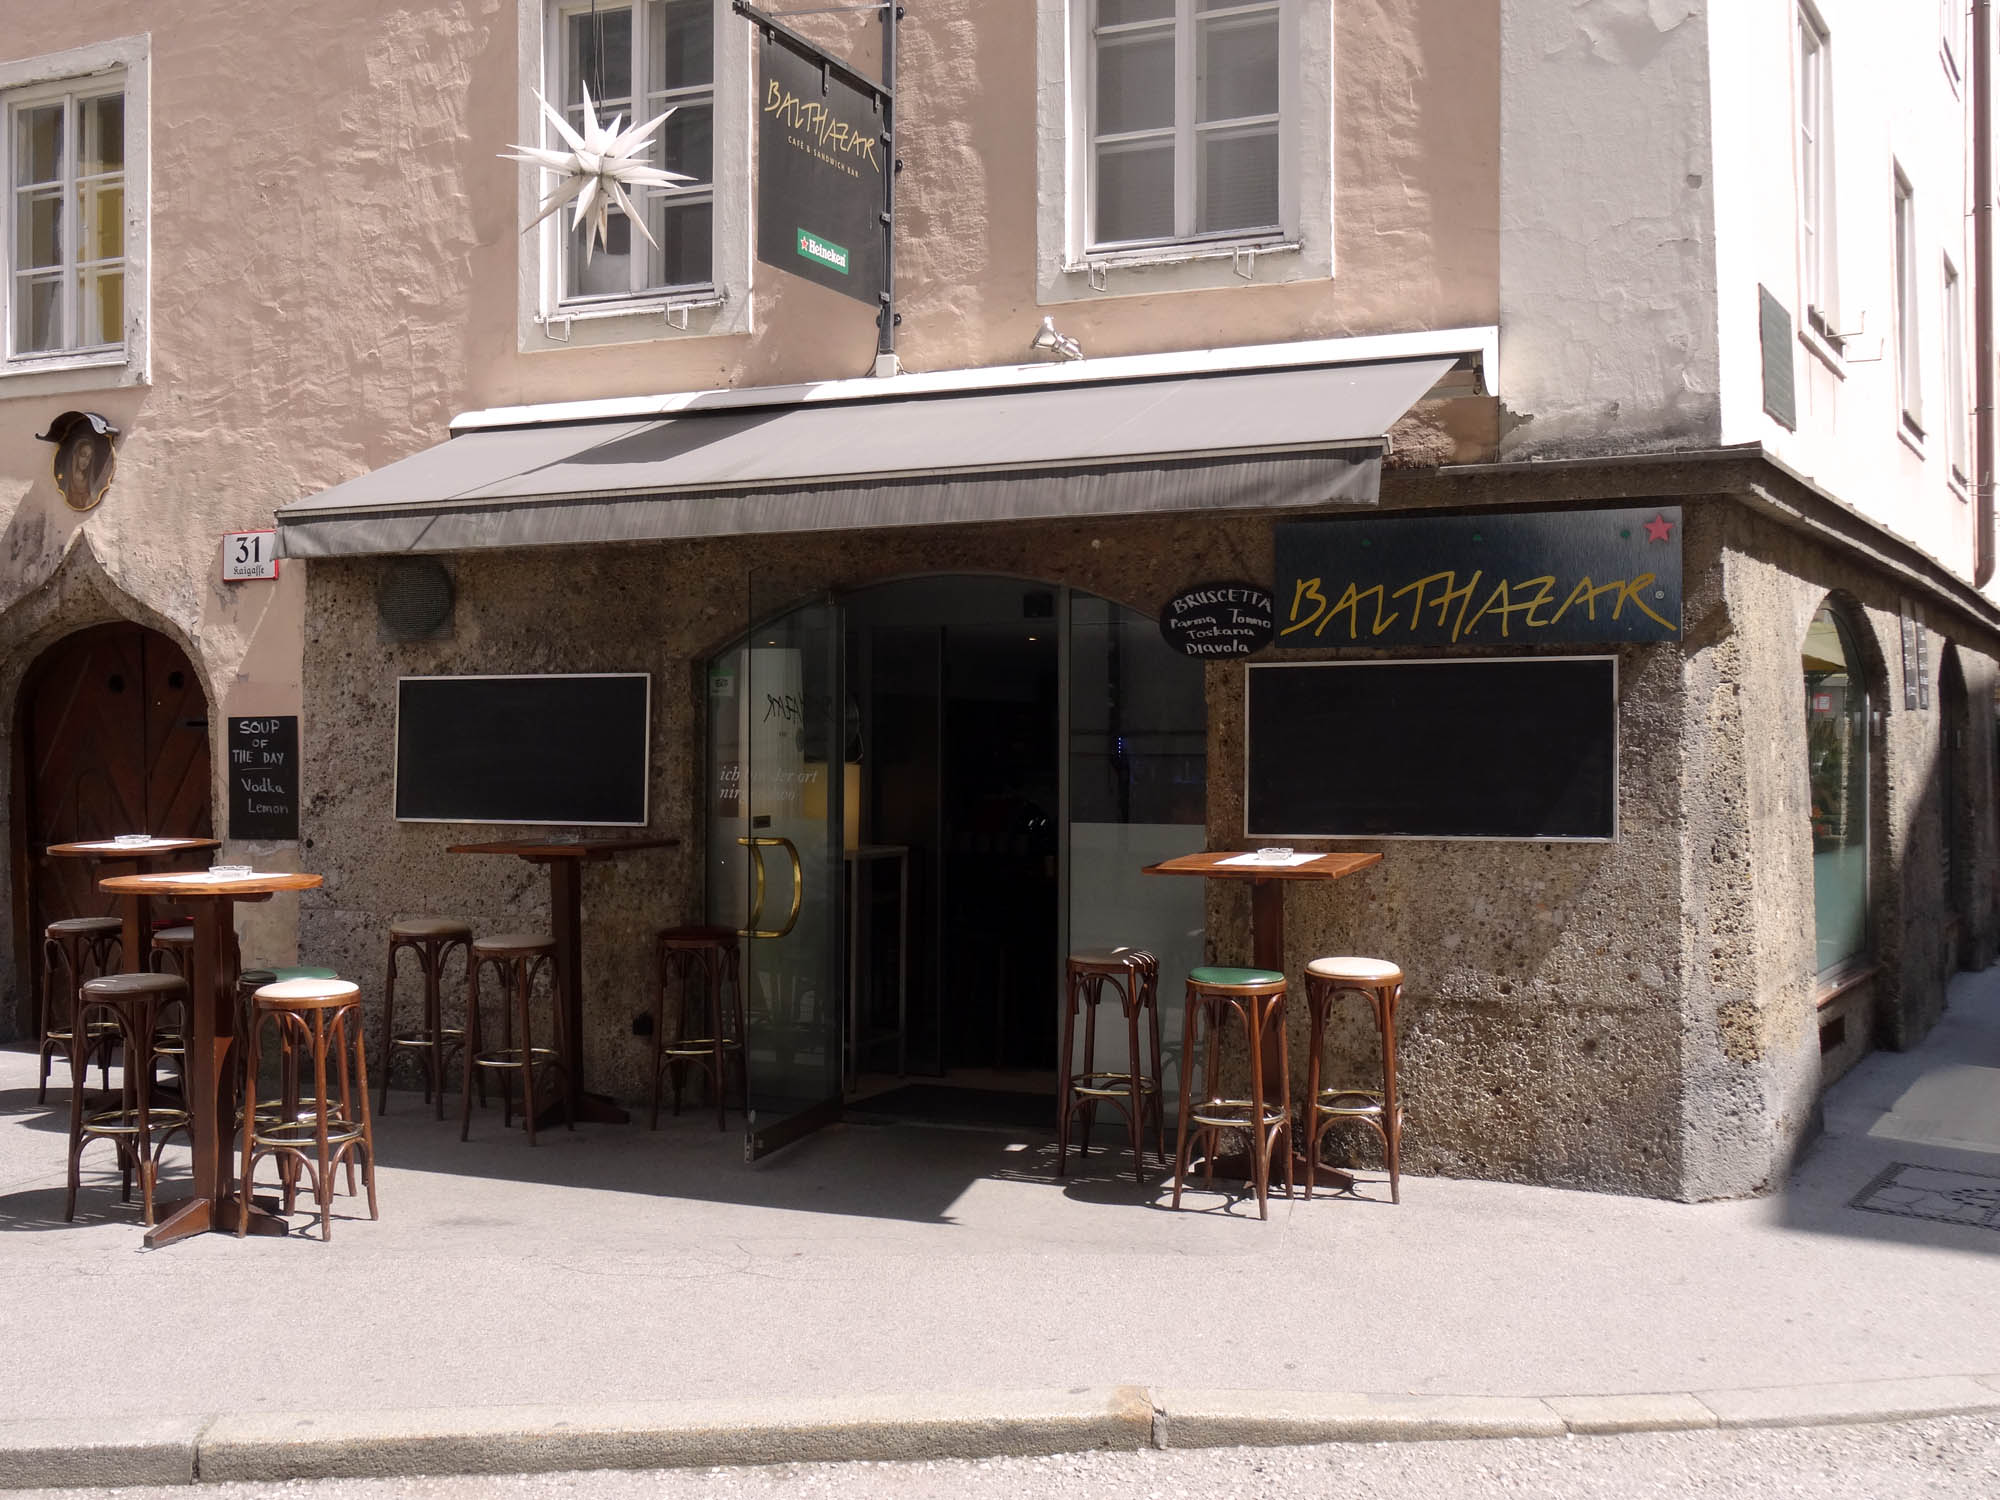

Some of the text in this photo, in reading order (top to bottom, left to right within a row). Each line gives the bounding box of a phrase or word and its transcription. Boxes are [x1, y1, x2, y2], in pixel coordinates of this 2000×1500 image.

[765, 79, 879, 173] BALTHAZAR
[814, 148, 845, 171] SANDWICH
[847, 167, 859, 178] BAR
[809, 239, 846, 267] Heineken
[235, 536, 260, 563] 31
[1172, 589, 1272, 614] BRUSCETTA
[1280, 570, 1677, 642] BALTHAZAR
[1170, 616, 1216, 629] Parma
[1186, 626, 1254, 640] Toskana
[1186, 640, 1249, 654] Diavola
[240, 720, 280, 734] SOUP
[252, 739, 269, 748] OF
[232, 750, 284, 766] THE DAY
[241, 777, 285, 794] Vodka
[248, 798, 288, 814] Lemon
